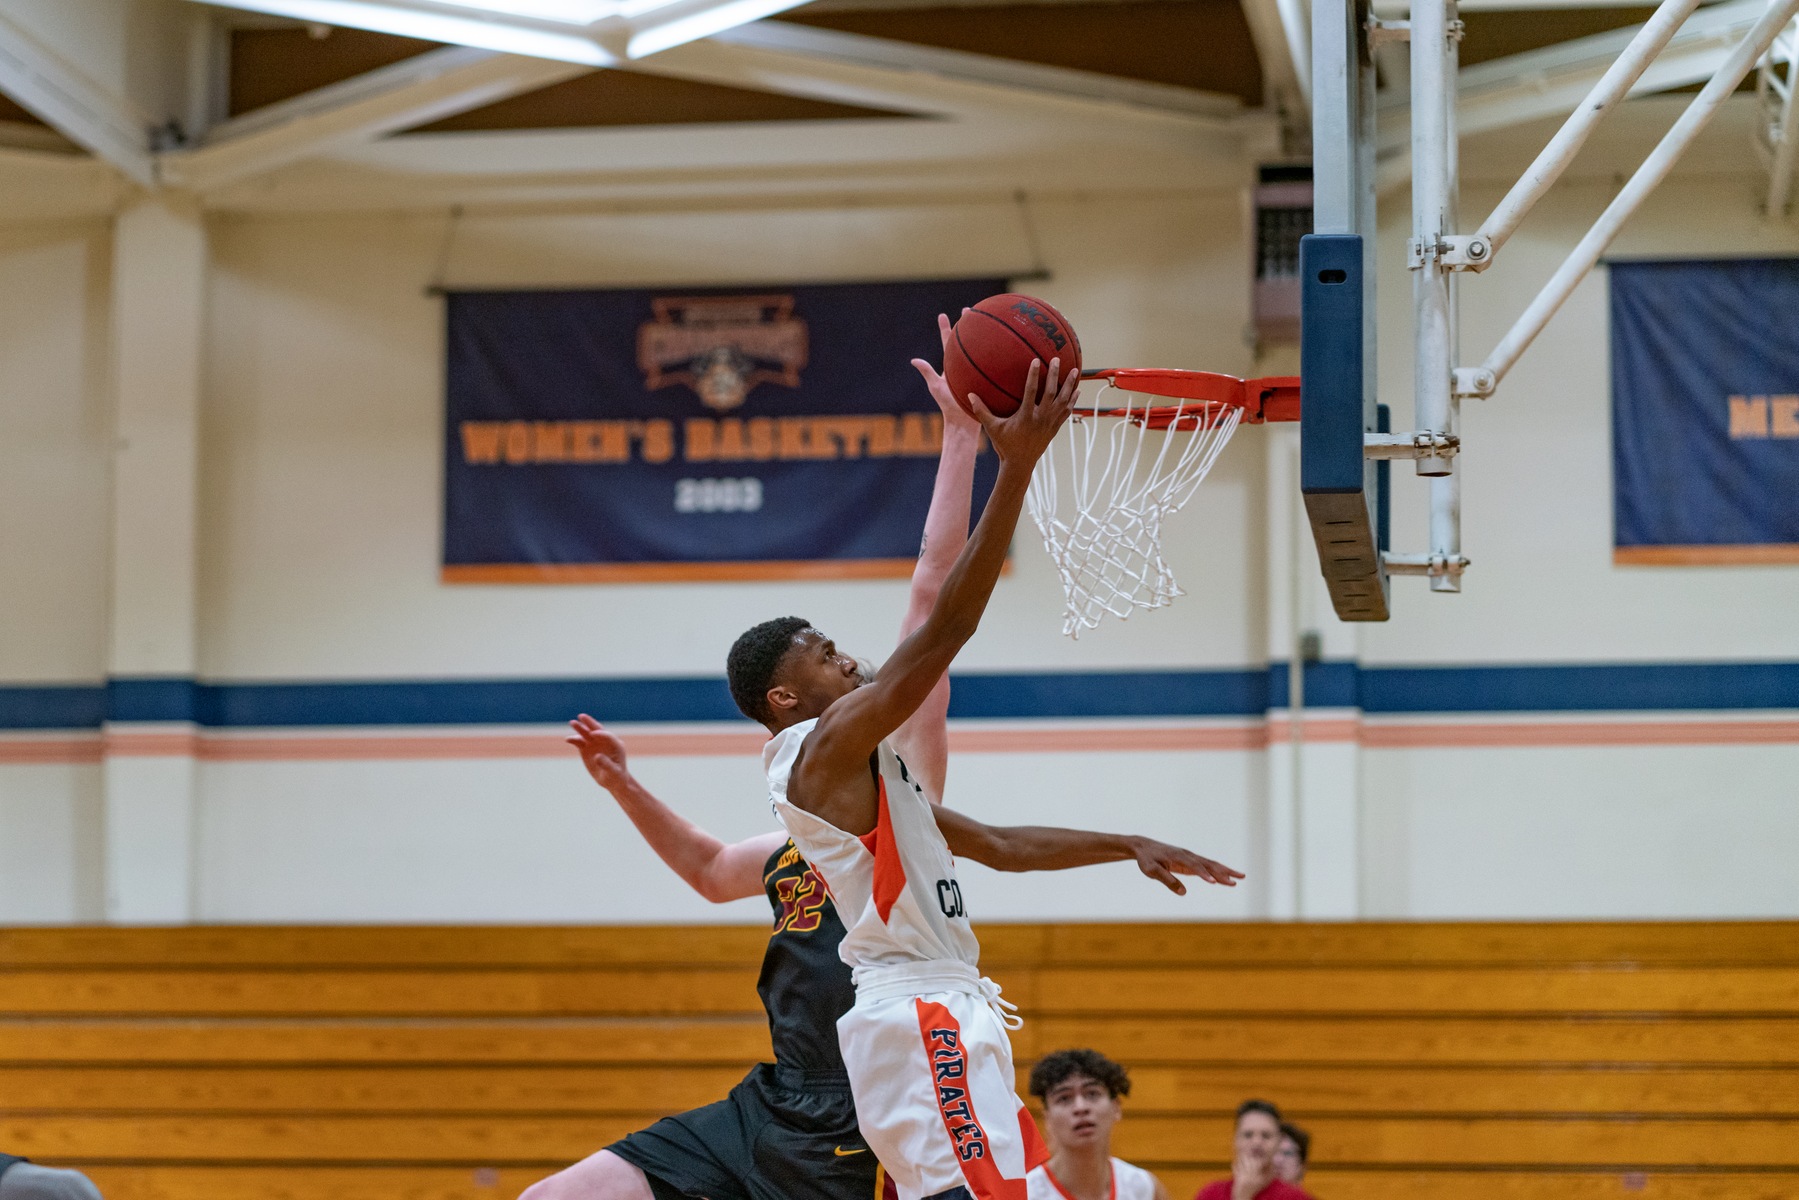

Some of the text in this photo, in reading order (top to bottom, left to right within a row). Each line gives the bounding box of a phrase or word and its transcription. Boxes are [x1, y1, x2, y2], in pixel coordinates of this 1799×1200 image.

[1010, 301, 1067, 351] NCAA
[461, 419, 674, 464] WOMEN'S
[936, 879, 968, 918] CO
[930, 1028, 985, 1162] PIRATES
